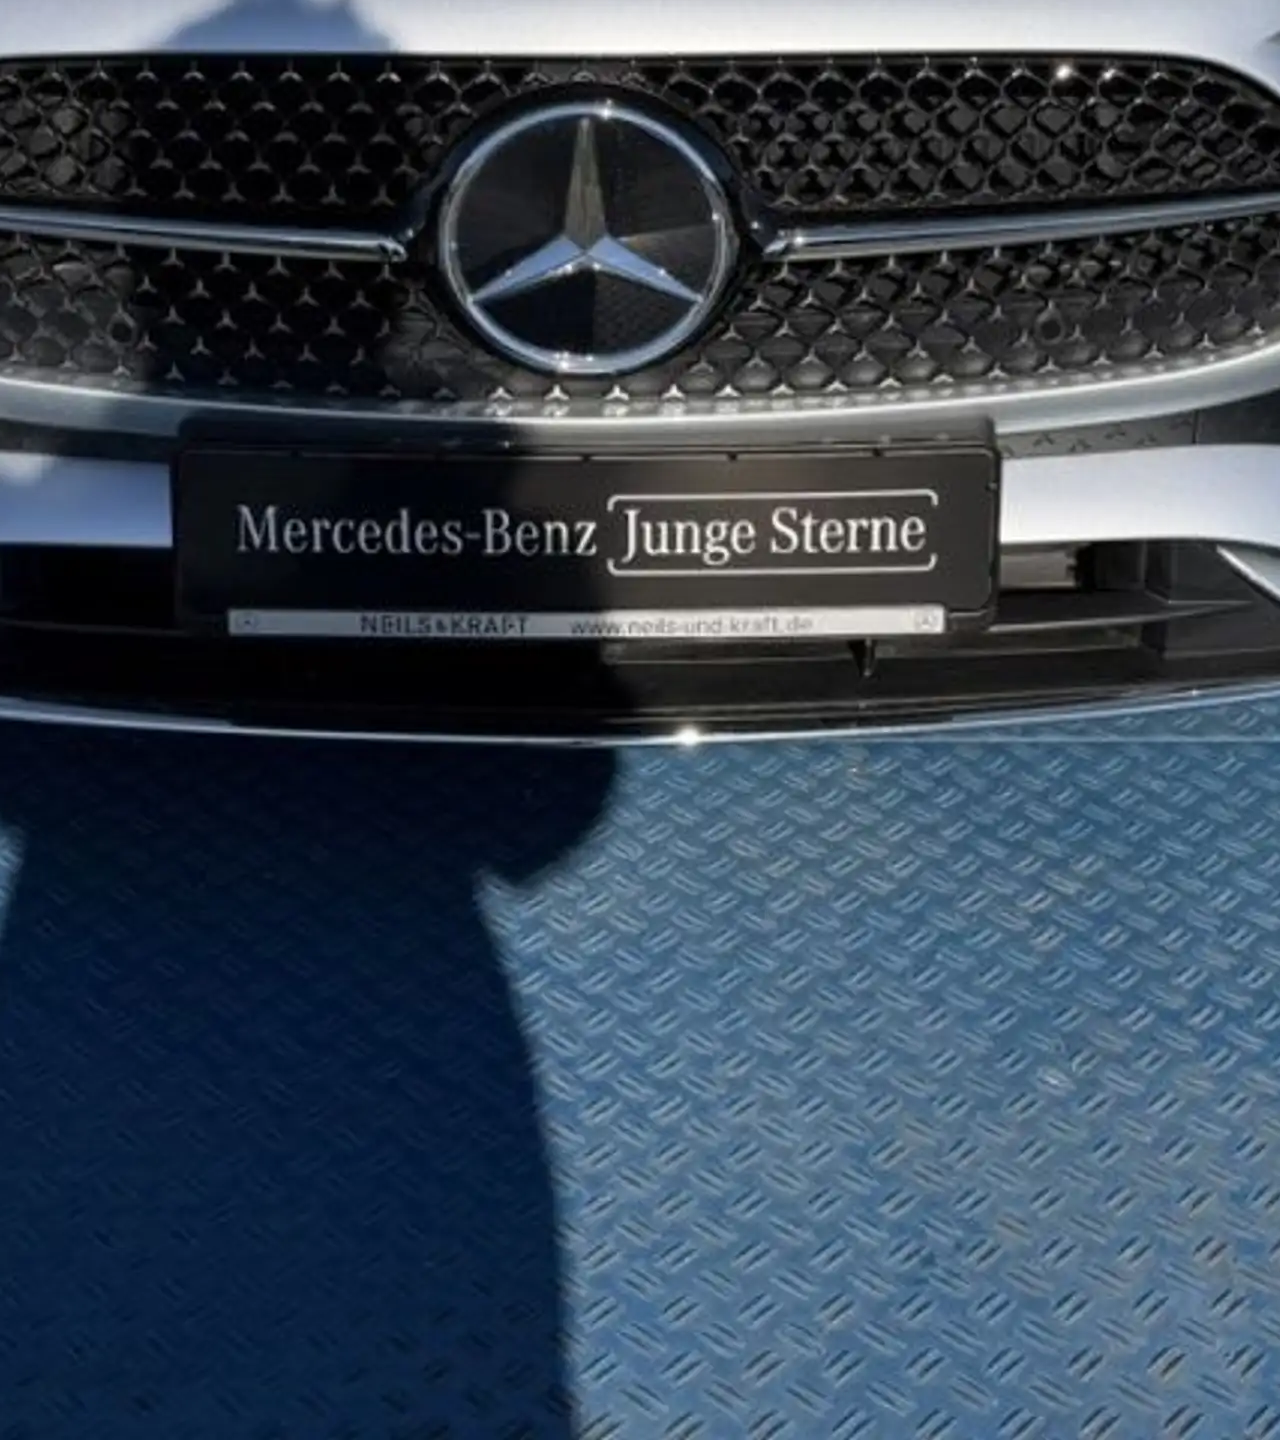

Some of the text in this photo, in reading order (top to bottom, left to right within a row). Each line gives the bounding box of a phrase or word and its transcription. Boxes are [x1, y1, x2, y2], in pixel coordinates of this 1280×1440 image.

[237, 505, 926, 565] Mercedes-Benz Junge Sterne
[570, 616, 814, 636] www.neils-undkraft.de
